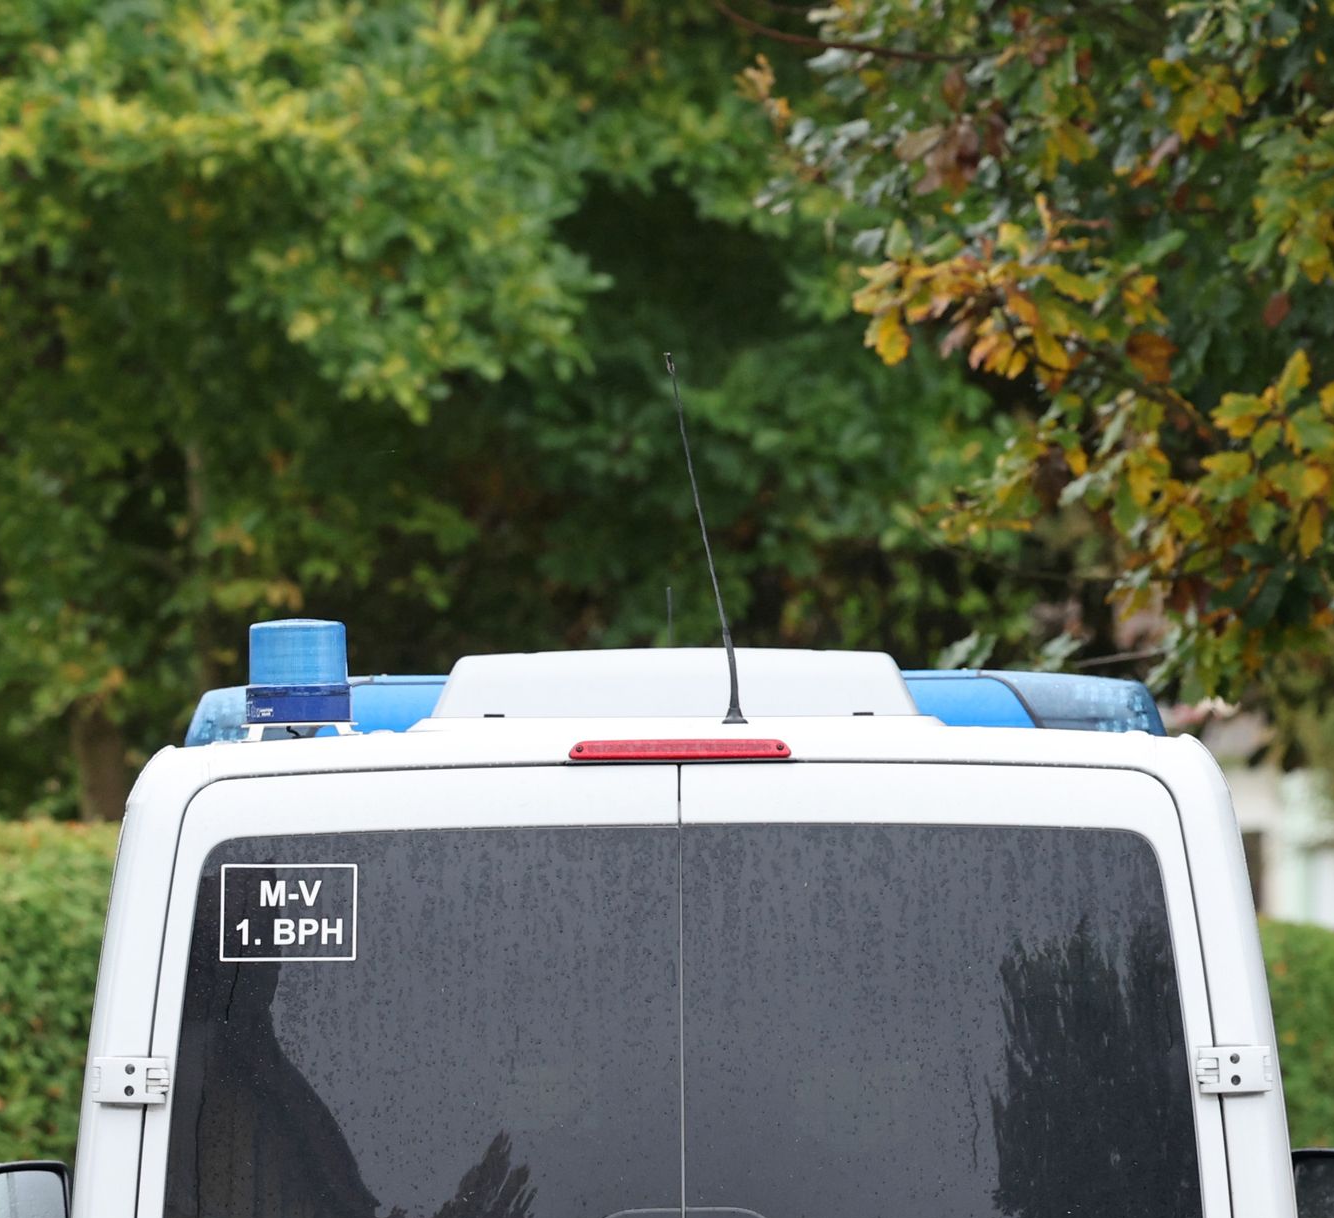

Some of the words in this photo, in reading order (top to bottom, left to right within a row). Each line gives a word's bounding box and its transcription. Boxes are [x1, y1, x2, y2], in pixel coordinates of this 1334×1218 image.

[259, 880, 323, 907] M-V
[235, 918, 262, 946] 1.
[273, 918, 343, 945] BPH
